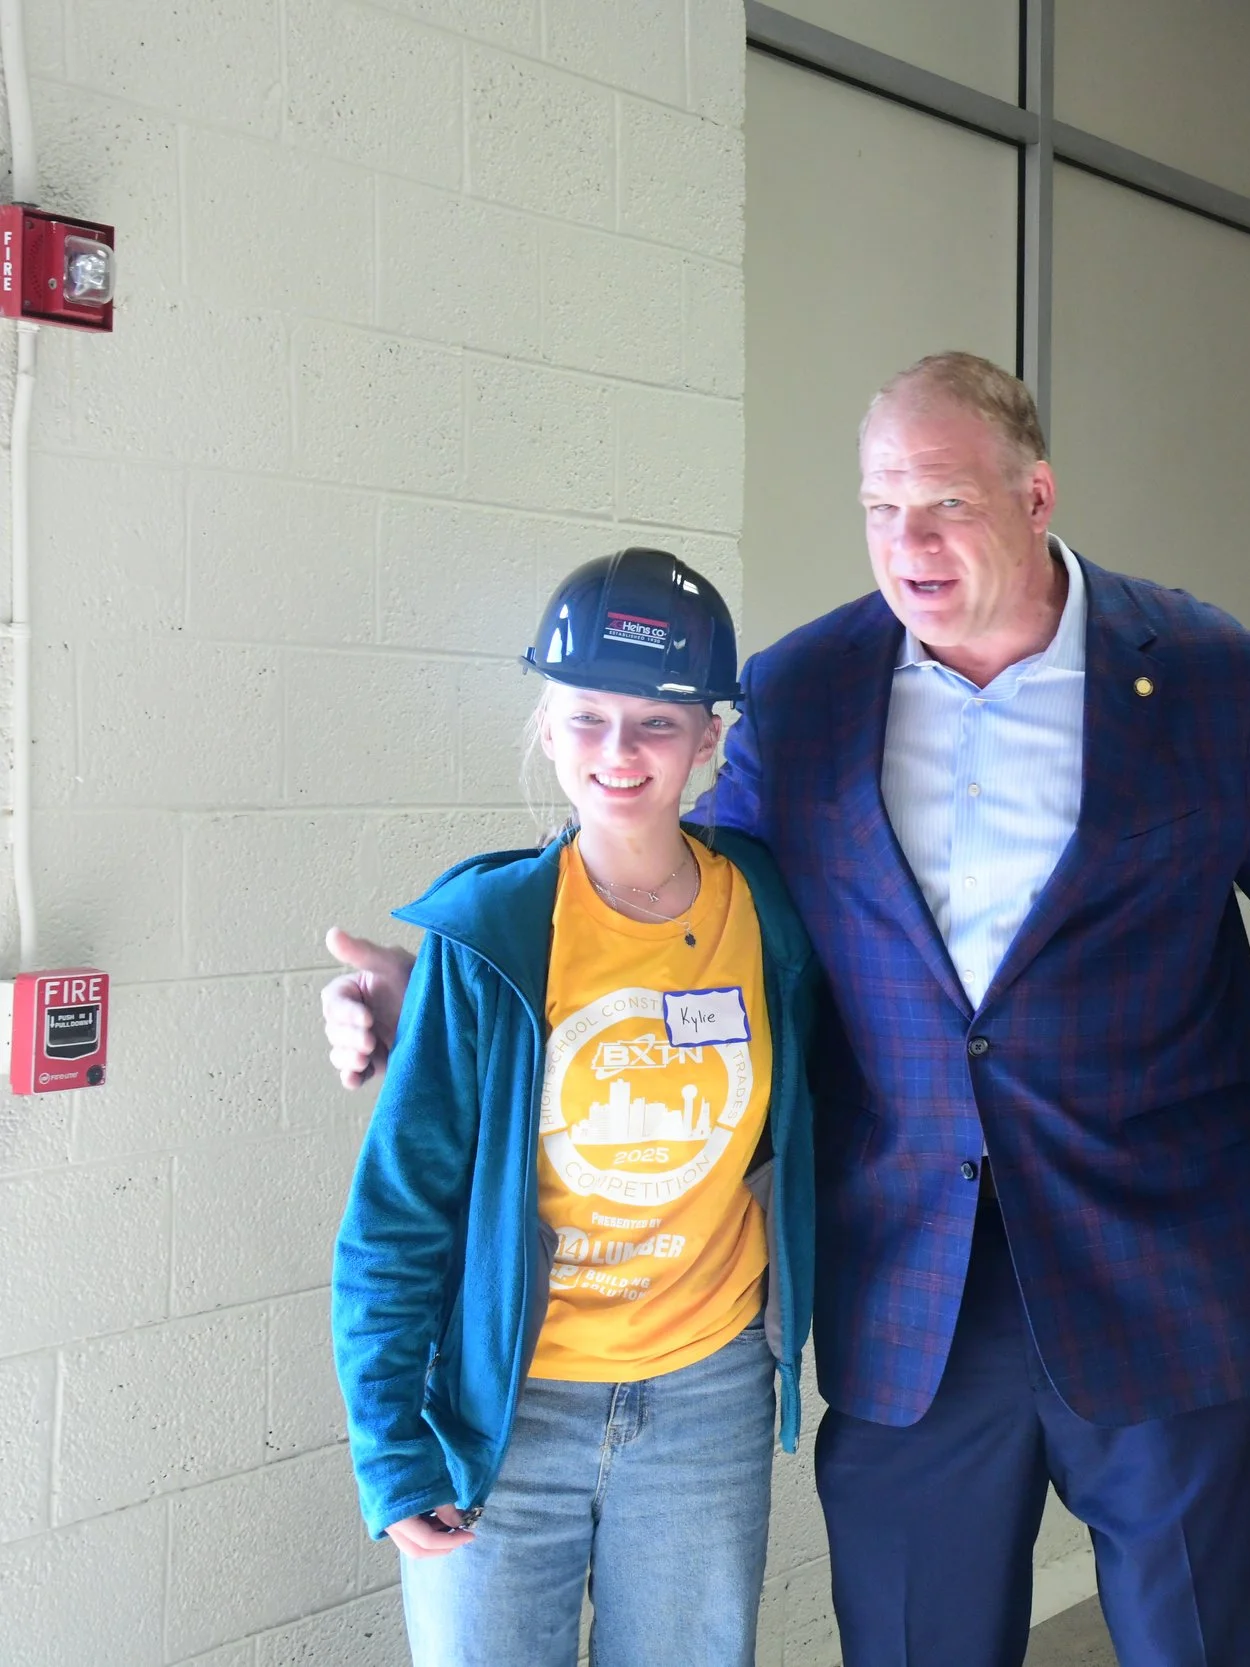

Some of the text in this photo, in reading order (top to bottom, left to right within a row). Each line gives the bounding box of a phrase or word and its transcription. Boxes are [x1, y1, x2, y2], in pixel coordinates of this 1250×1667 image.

[4, 232, 12, 291] FIRE
[609, 630, 645, 640] ESTABLISHED
[44, 978, 102, 1005] FIRE
[58, 1014, 75, 1022] PUSH
[680, 1007, 716, 1033] Kylie
[547, 1016, 599, 1075] SCHOOL
[727, 1050, 747, 1120] TRADES
[541, 1082, 555, 1126] HIGH
[613, 1147, 670, 1165] 2025
[585, 1269, 651, 1289] BUILDNG
